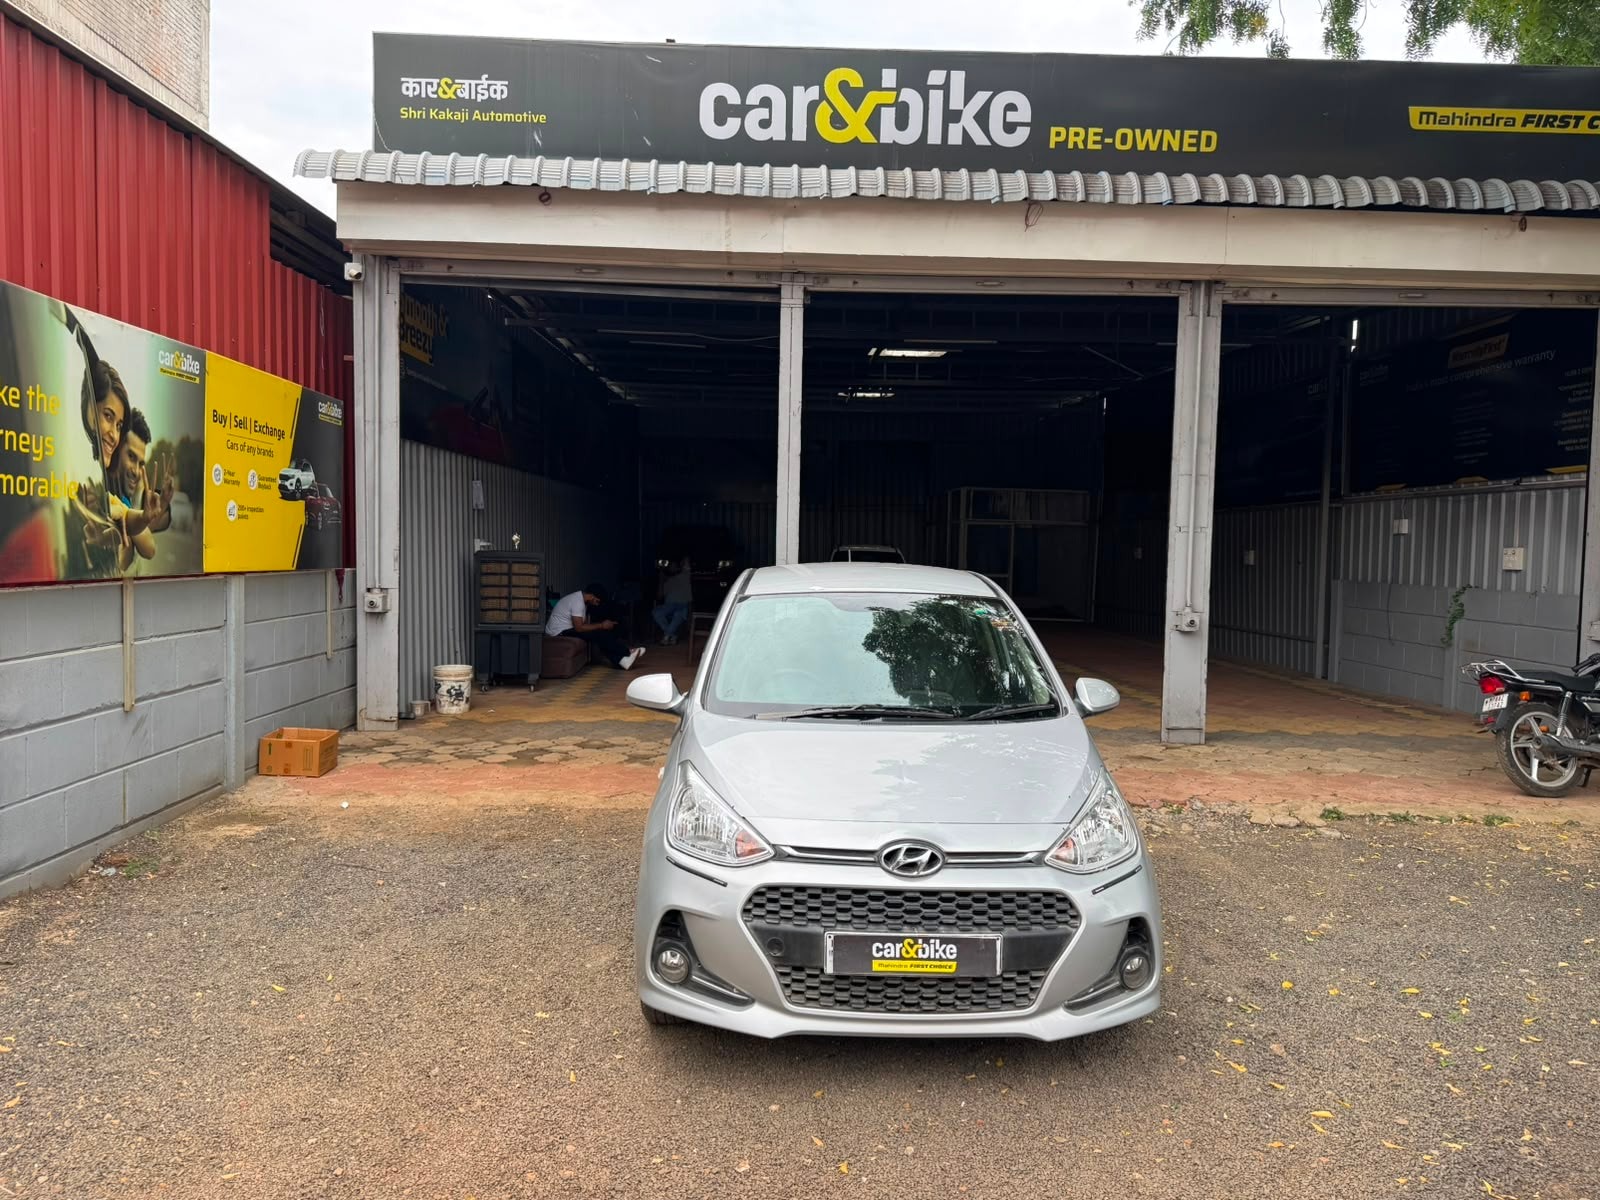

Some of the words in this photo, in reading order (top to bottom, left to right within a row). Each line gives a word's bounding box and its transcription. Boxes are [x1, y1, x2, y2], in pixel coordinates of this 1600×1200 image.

[400, 107, 426, 119] Shri
[430, 108, 469, 123] Kakaji
[472, 110, 547, 124] Automotive
[699, 67, 1032, 147] car&bike
[1419, 111, 1516, 128] Mahindra
[1521, 114, 1584, 129] FIRST
[1049, 126, 1218, 152] PRE-OWNED
[159, 350, 200, 374] car&bike
[27, 384, 61, 415] the
[213, 409, 227, 428] Buy
[234, 415, 248, 430] Sell
[254, 420, 285, 440] Exchange
[227, 439, 239, 451] Cars
[240, 442, 246, 452] of
[247, 445, 256, 456] any
[257, 446, 274, 458] brands
[872, 938, 957, 960] car&bike
